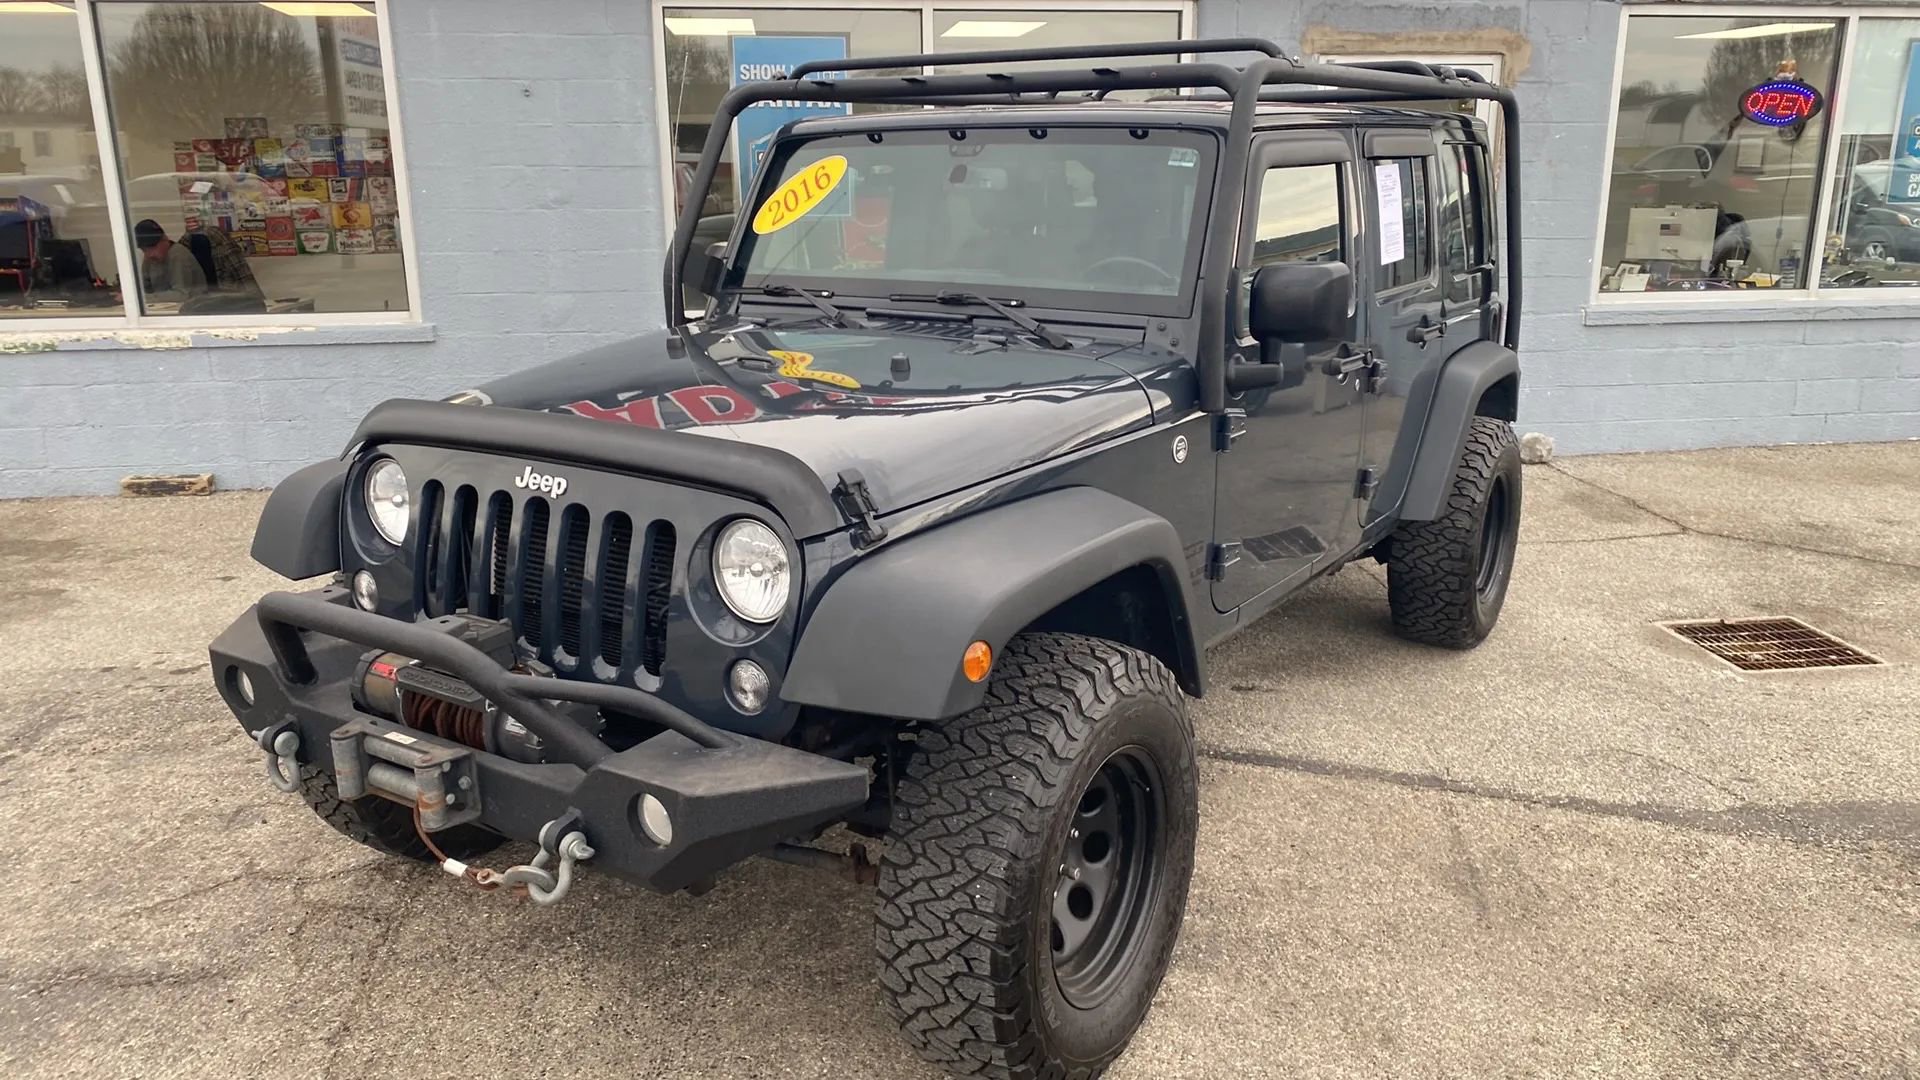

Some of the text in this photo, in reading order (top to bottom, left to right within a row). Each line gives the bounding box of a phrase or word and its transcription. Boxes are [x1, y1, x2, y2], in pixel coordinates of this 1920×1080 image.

[1746, 91, 1815, 117] OPEN
[767, 165, 831, 227] 2016
[514, 465, 568, 500] Jeep
